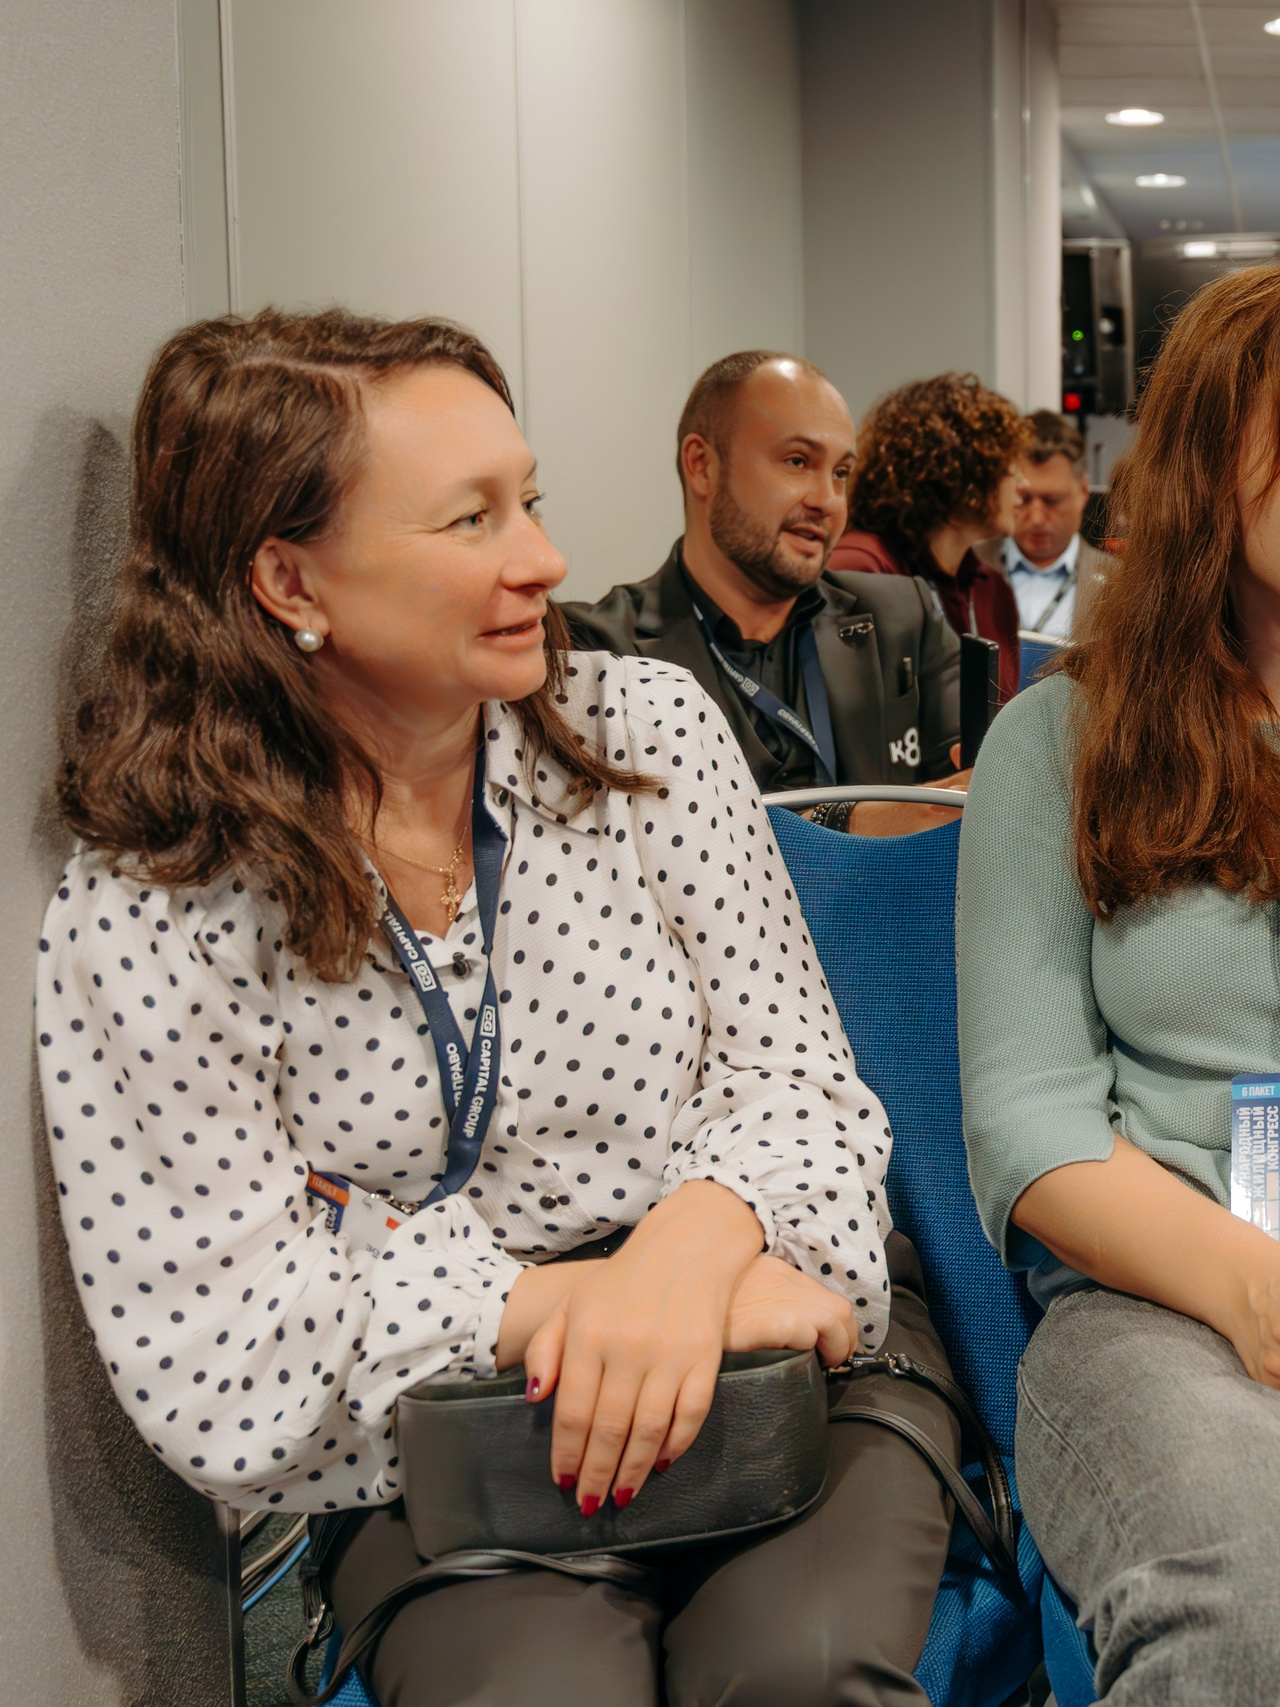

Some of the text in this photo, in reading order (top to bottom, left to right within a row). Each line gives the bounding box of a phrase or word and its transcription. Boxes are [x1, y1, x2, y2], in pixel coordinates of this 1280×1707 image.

[385, 911, 434, 989] CG CAPITAL
[446, 1042, 465, 1091] ПРАВО
[463, 1007, 494, 1139] CG CAPITAL GROUP
[1249, 1085, 1276, 1097] ПАКЕТ
[1236, 1106, 1253, 1199] УНАРОДНЫЙ
[1250, 1106, 1267, 1201] ЖИЛИЩНЫЙ
[1266, 1105, 1279, 1170] КОНГРЕСС
